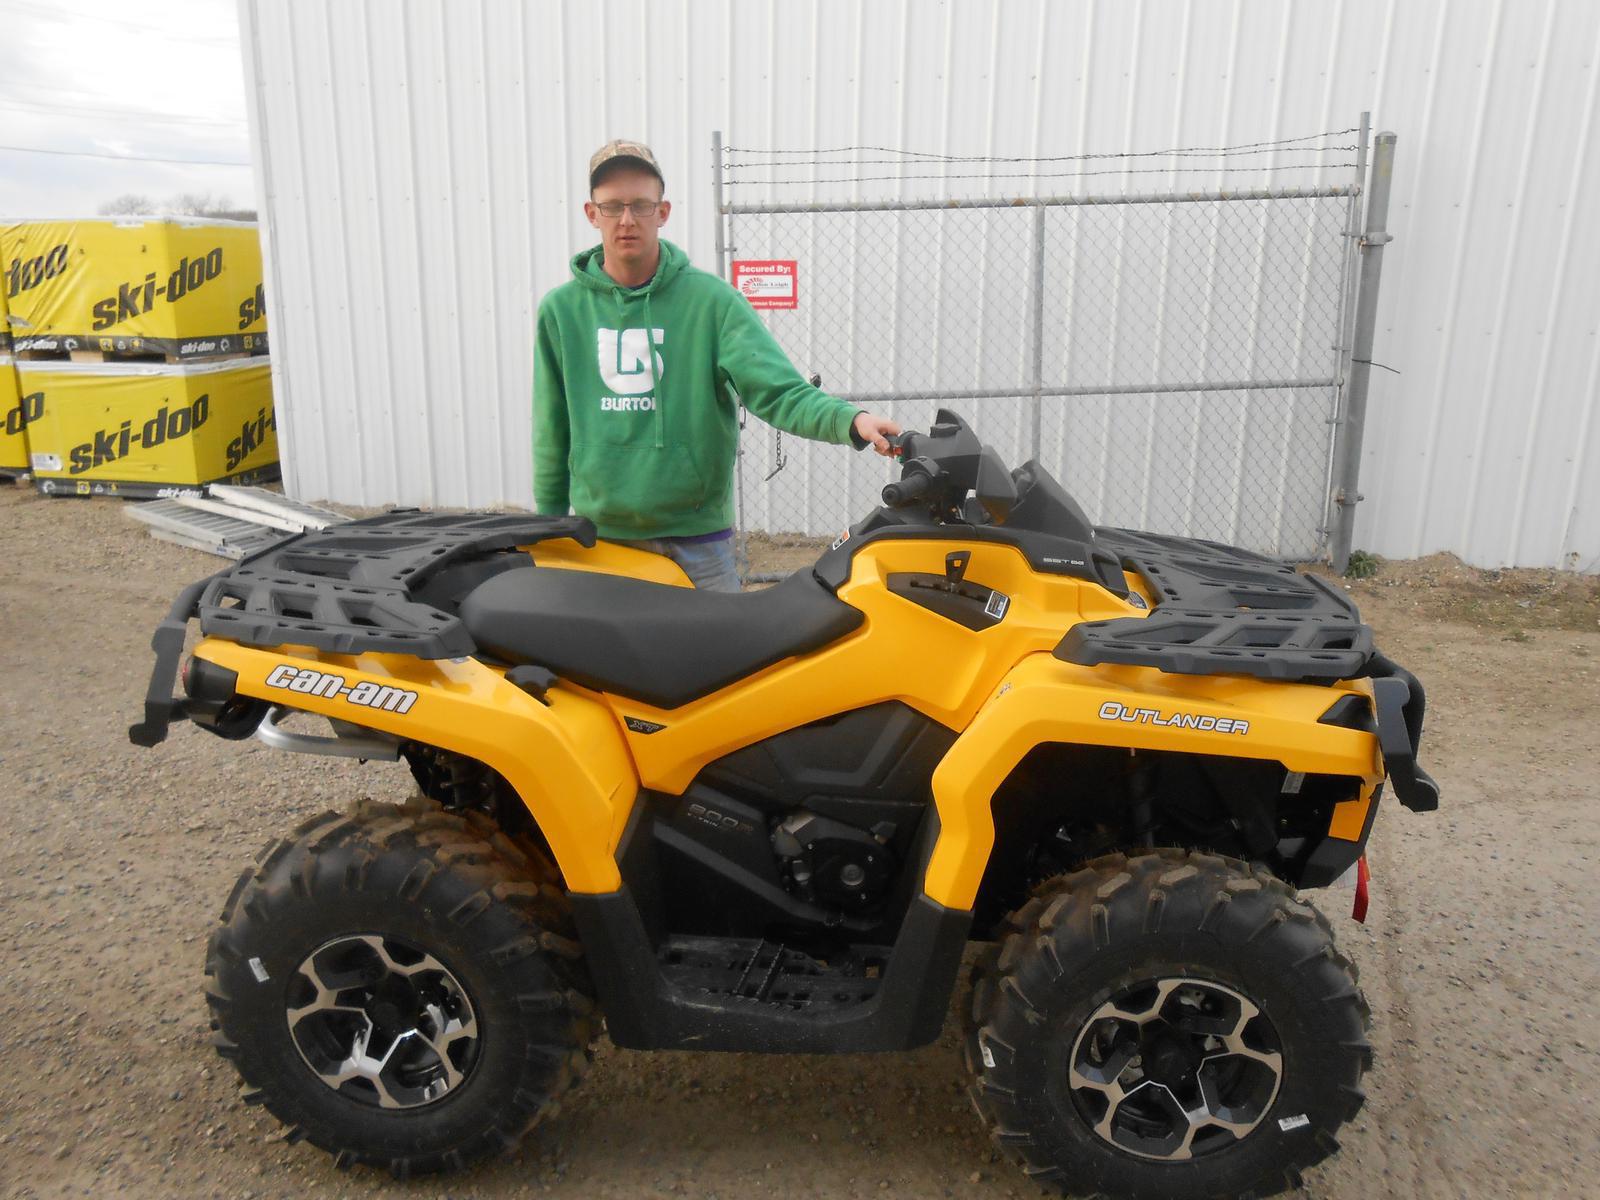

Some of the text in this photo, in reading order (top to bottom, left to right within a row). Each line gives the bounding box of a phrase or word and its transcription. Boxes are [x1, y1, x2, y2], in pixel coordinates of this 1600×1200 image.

[93, 247, 223, 331] ski-doo
[739, 264, 792, 274] Secured By:
[181, 341, 216, 354] ski-doo
[69, 393, 209, 475] ski-doo
[226, 406, 276, 472] ski-
[265, 664, 418, 715] can-am
